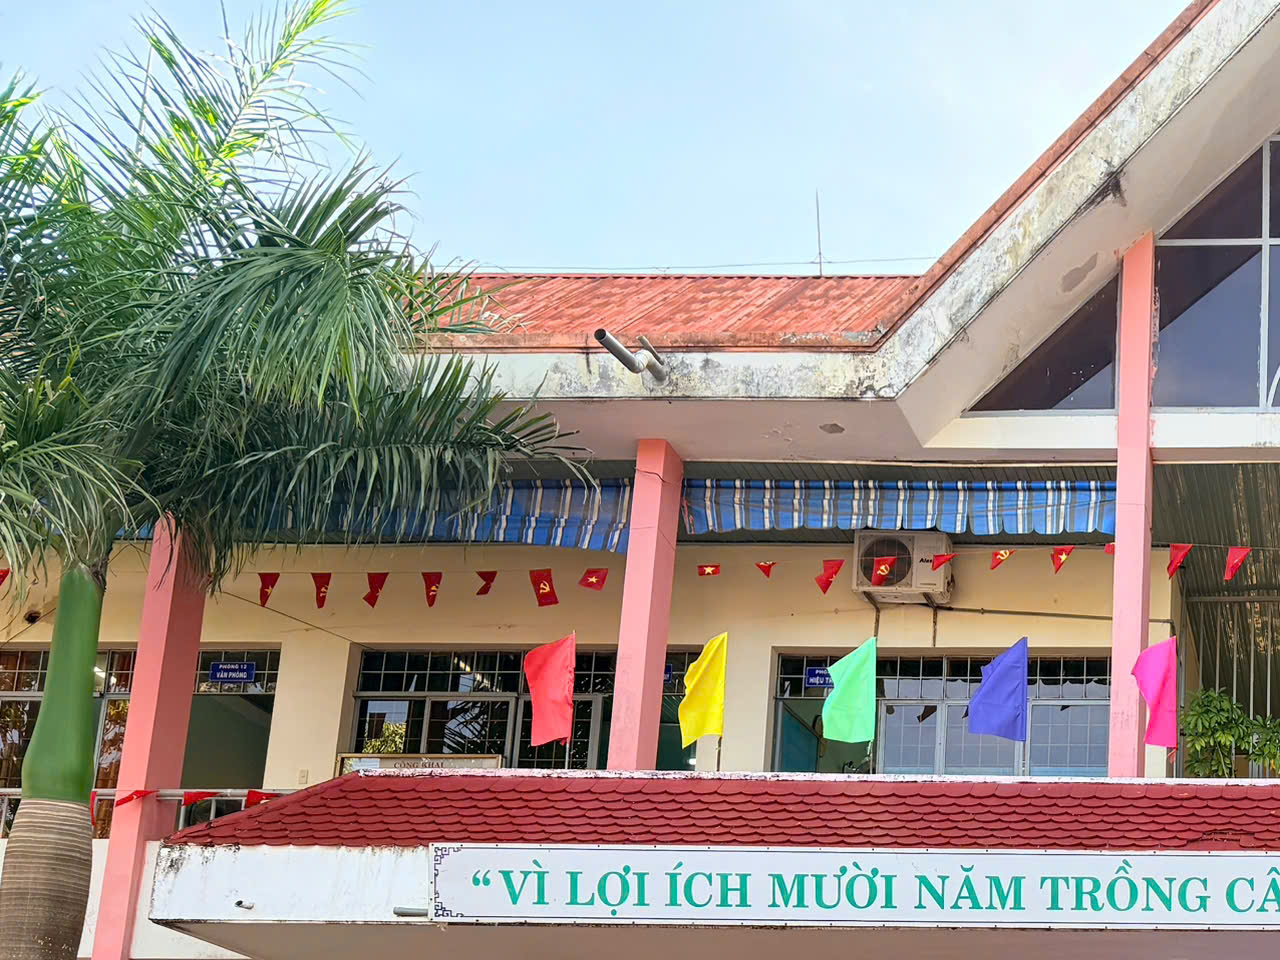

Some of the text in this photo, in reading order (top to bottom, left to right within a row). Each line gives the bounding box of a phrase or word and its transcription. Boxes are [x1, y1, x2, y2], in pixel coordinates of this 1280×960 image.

[393, 761, 419, 769] CÔNG
[565, 865, 649, 917] LỢI
[665, 862, 753, 909] ÍCH
[768, 862, 897, 911] MƯỜI
[914, 865, 1025, 912] NĂM
[1040, 859, 1209, 913] TRỒNG
